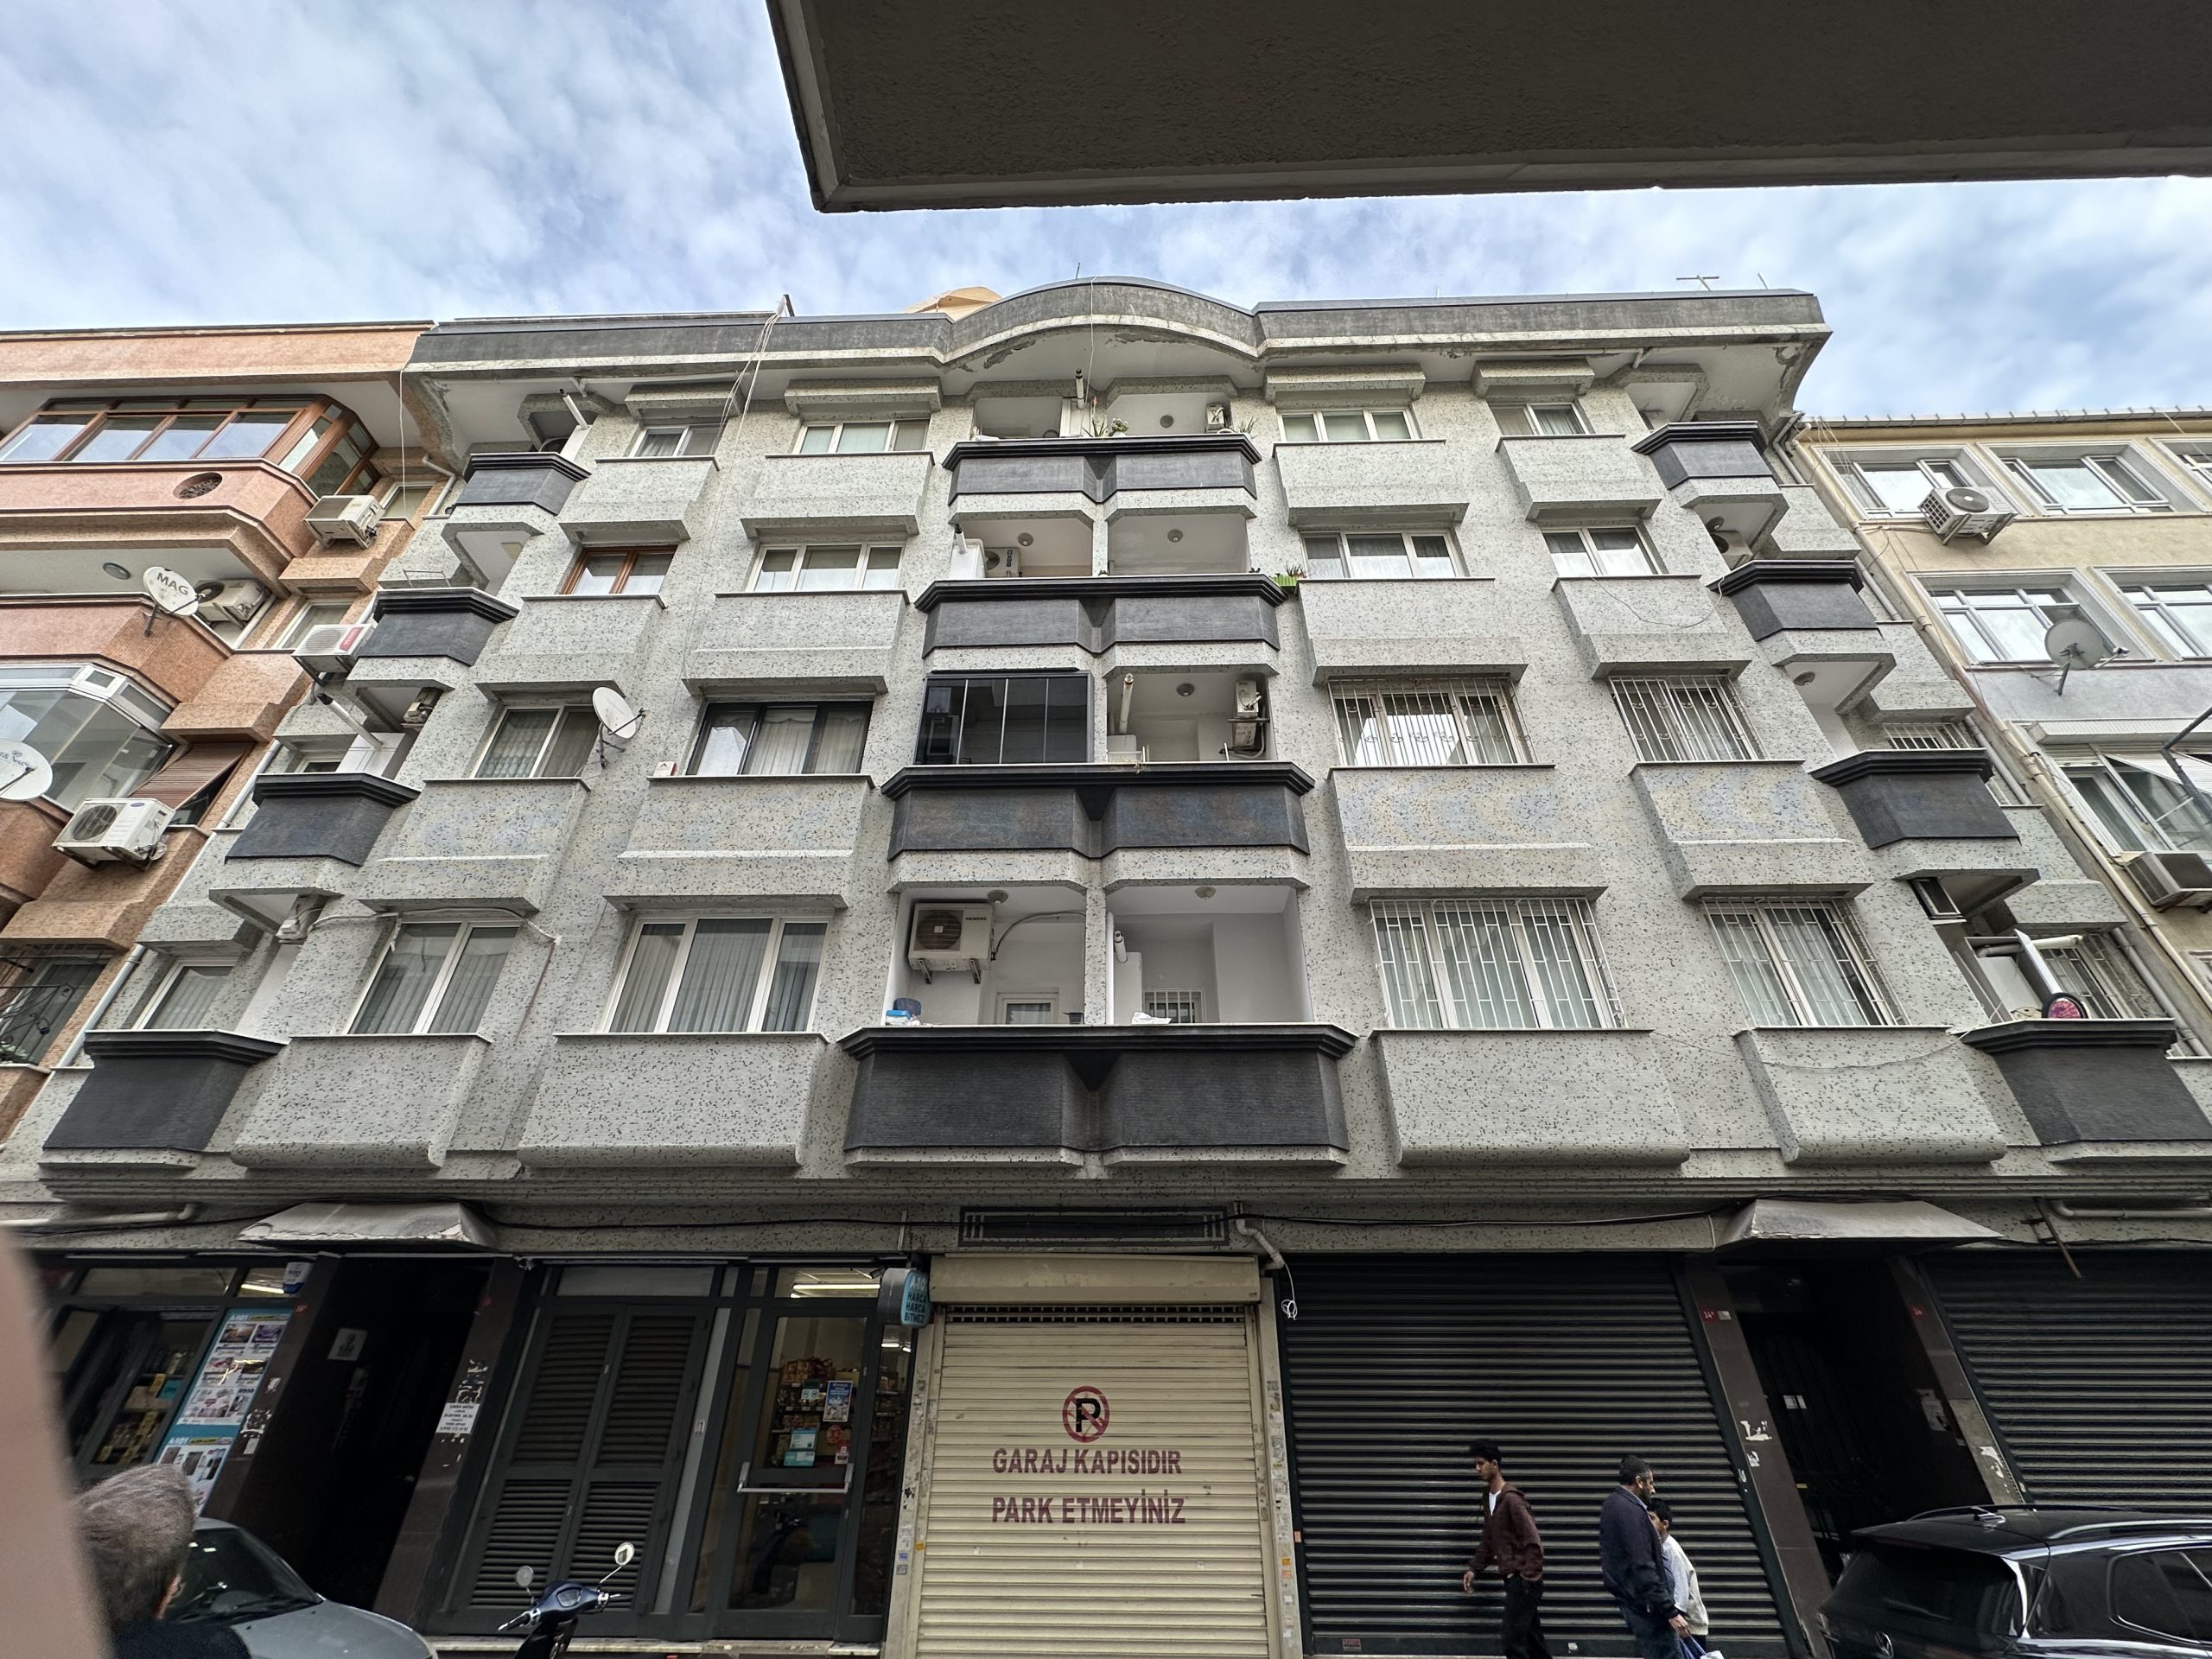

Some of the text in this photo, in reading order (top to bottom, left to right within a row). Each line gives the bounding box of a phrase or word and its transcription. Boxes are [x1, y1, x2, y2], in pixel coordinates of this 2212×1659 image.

[156, 572, 188, 595] MAG
[906, 1291, 927, 1303] HARCA
[906, 1301, 925, 1313] HARCA
[992, 1448, 1183, 1474] GARAJ KAPISIDIR
[992, 1488, 1186, 1523] PARK ETMEYİNİZ
